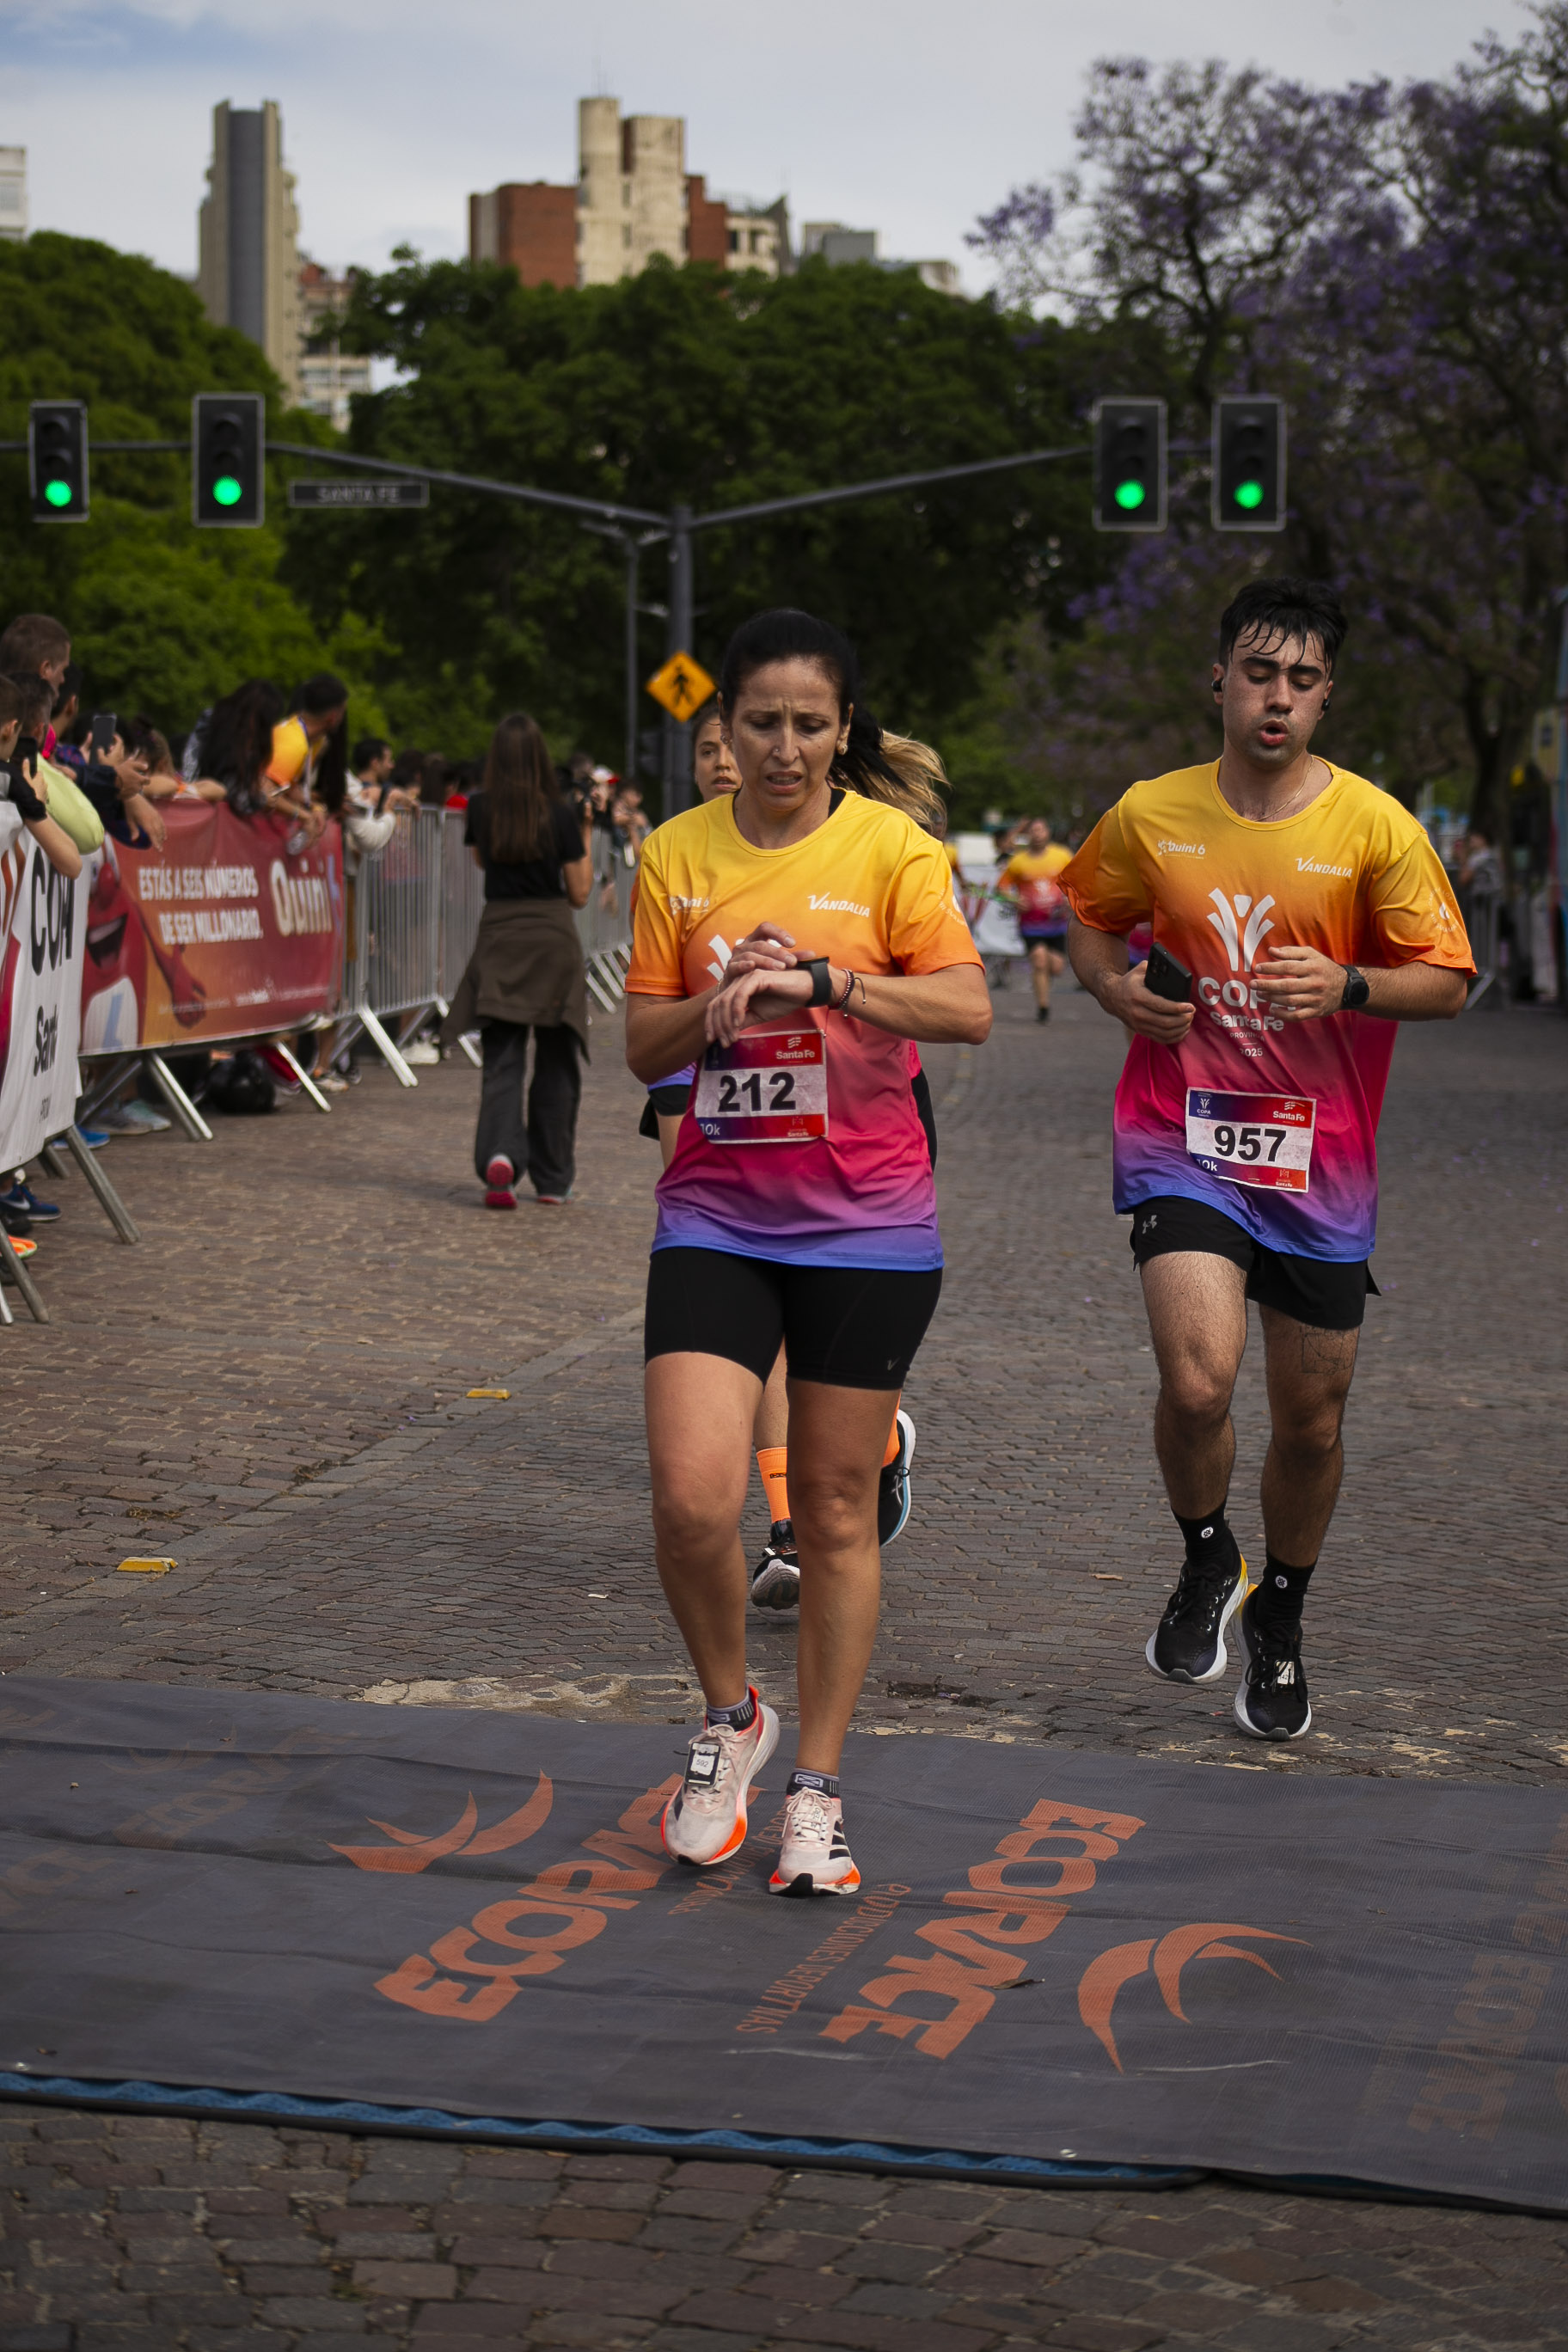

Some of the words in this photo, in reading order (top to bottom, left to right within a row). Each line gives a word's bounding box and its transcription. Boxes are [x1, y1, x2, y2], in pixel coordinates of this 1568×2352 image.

[1167, 841, 1197, 854] Quini
[1197, 843, 1205, 855] 6
[1295, 855, 1353, 878] VANDALIA
[174, 867, 183, 900] A
[182, 867, 205, 900] SEIS
[204, 858, 259, 899] NÚMEROS
[807, 891, 871, 918] VANDALIA
[159, 912, 175, 946] DE
[174, 911, 195, 945] SER
[1198, 977, 1296, 1012] COP
[1210, 1012, 1262, 1031] Santa
[1263, 1015, 1284, 1032] Fe
[775, 1050, 804, 1060] Santa
[805, 1049, 816, 1058] Fe
[1239, 1048, 1263, 1057] 2025
[718, 1072, 796, 1112] 212
[1272, 1111, 1295, 1121] Santa
[1295, 1113, 1306, 1122] Fe
[700, 1124, 720, 1136] 10k
[1214, 1125, 1287, 1162] 957
[696, 1758, 709, 1768] 592
[817, 1800, 1148, 2061] ECORACE
